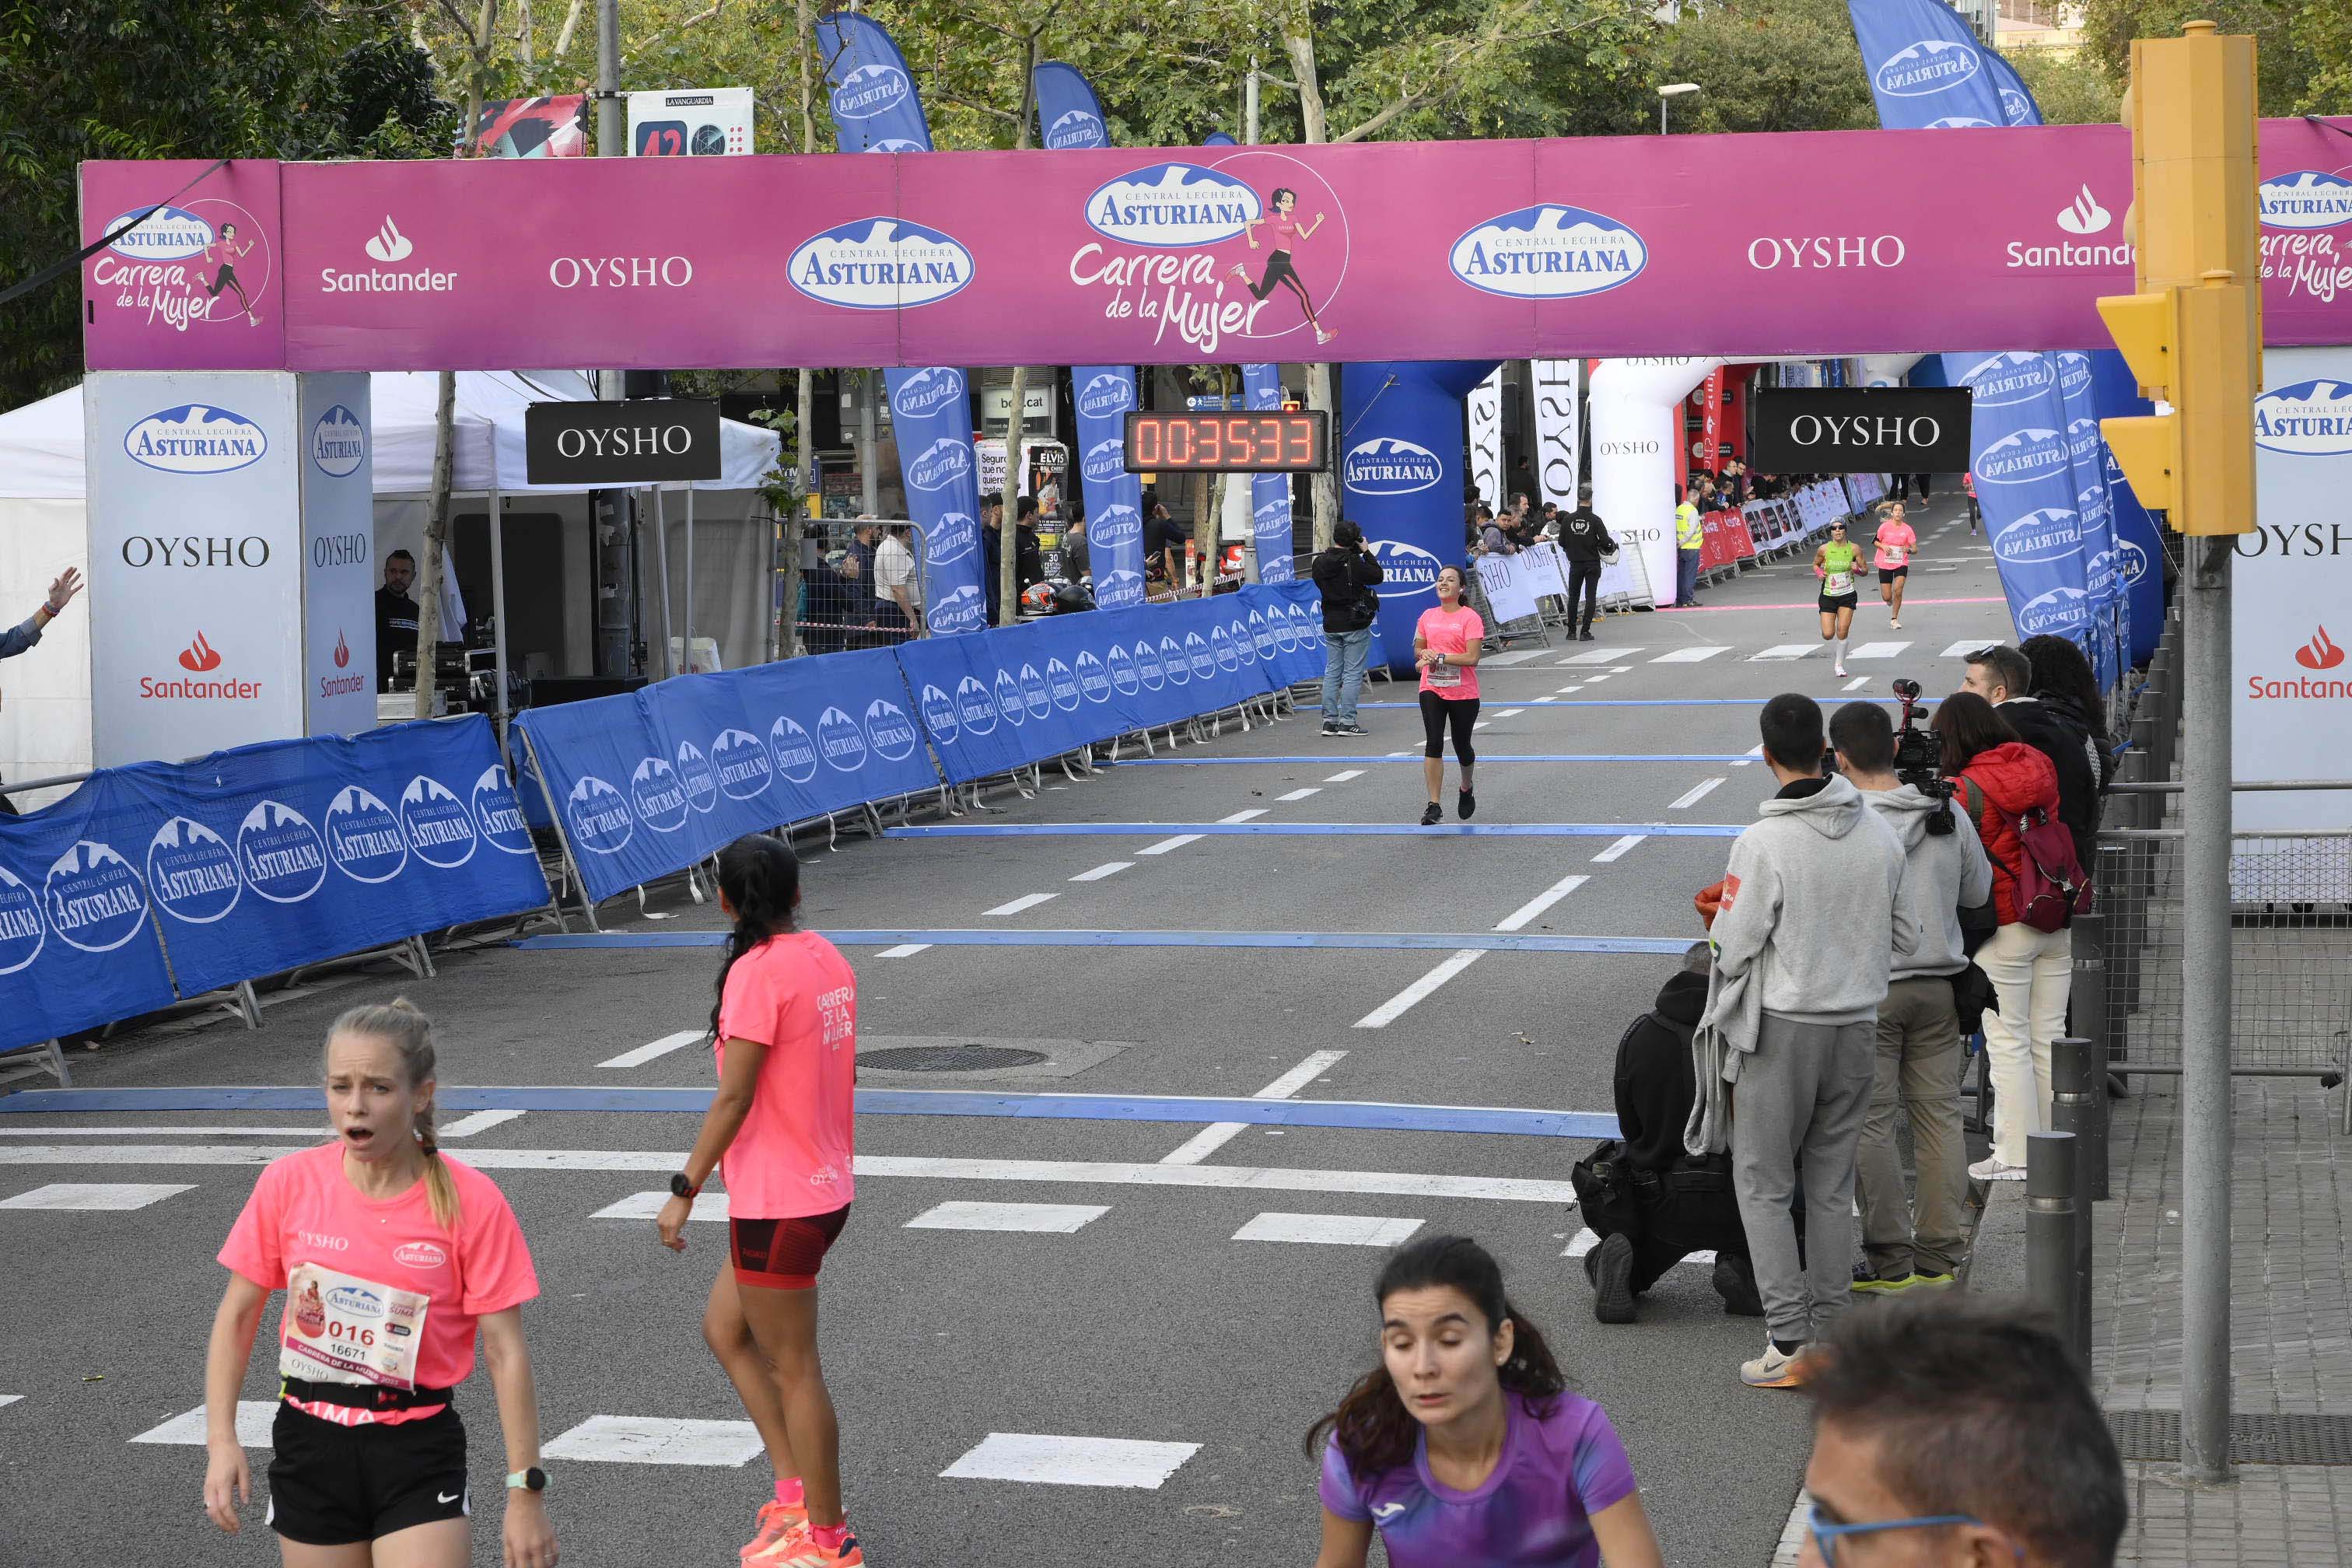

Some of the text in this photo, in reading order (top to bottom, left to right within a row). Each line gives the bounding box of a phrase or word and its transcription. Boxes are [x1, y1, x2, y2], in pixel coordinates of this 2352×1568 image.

[1125, 191, 1244, 201] CENTRAL LECHERA
[1098, 194, 1247, 226] ASTURIANA
[112, 226, 205, 247] ASTURIANA
[1495, 236, 1625, 247] CENTRAL LECHERA
[2260, 234, 2334, 256] arrera
[830, 249, 953, 258] CENTRAL LECHERA
[1069, 242, 1216, 286] Carrera
[1465, 241, 1632, 275] ASTURIANA
[1748, 235, 1905, 270] OYSHO
[2007, 241, 2136, 267] Santand
[93, 257, 186, 286] Carrera
[321, 268, 457, 292] Santander
[549, 256, 693, 288] OYSHO
[801, 251, 961, 285] ASTURIANA
[2278, 257, 2292, 278] la
[2288, 252, 2352, 303] Muje
[117, 283, 220, 331] de la Mujer
[1105, 280, 1269, 354] de la Mujer
[557, 425, 691, 458] OYSHO
[1138, 420, 1311, 464] 00:35:33
[1790, 415, 1941, 446] OYSHO
[135, 431, 257, 457] ASTURIANA
[316, 434, 361, 459] ASTURIANA
[1600, 440, 1659, 455] OYSHO
[1040, 453, 1064, 463] ELVIS
[1347, 461, 1434, 482] ASTURIANA
[1624, 528, 1661, 543] SHO
[2233, 523, 2352, 557] OYSH
[122, 536, 270, 568] OYSHO
[314, 533, 366, 568] OYSHO
[1383, 568, 1435, 583] RIANA
[139, 677, 262, 699] Santander
[320, 673, 364, 698] Santander
[1081, 672, 1108, 691] ASTURIANA
[777, 746, 814, 770] ASTURIANA
[822, 734, 863, 761] ASTURIANA
[716, 756, 769, 788] ASTURIANA
[407, 812, 473, 849] ASTURIANA
[481, 802, 524, 835] ASTUR
[281, 831, 311, 843] LECHERA
[334, 824, 404, 863] ASTURIANA
[196, 848, 226, 860] LECHERA
[246, 843, 323, 882] ASTURIANA
[156, 861, 237, 902] ASTURIANA
[817, 985, 855, 1012] CARRERA
[824, 1004, 849, 1027] DE LA
[823, 1020, 853, 1045] MUJER
[328, 1292, 381, 1315] ASTURIANA
[328, 1321, 375, 1346] 016
[298, 1344, 331, 1363] CARRERA
[331, 1344, 366, 1361] 16671
[291, 1358, 329, 1380] OYSHO
[331, 1360, 342, 1369] DE
[343, 1363, 355, 1371] LA
[355, 1365, 380, 1381] MUJER
